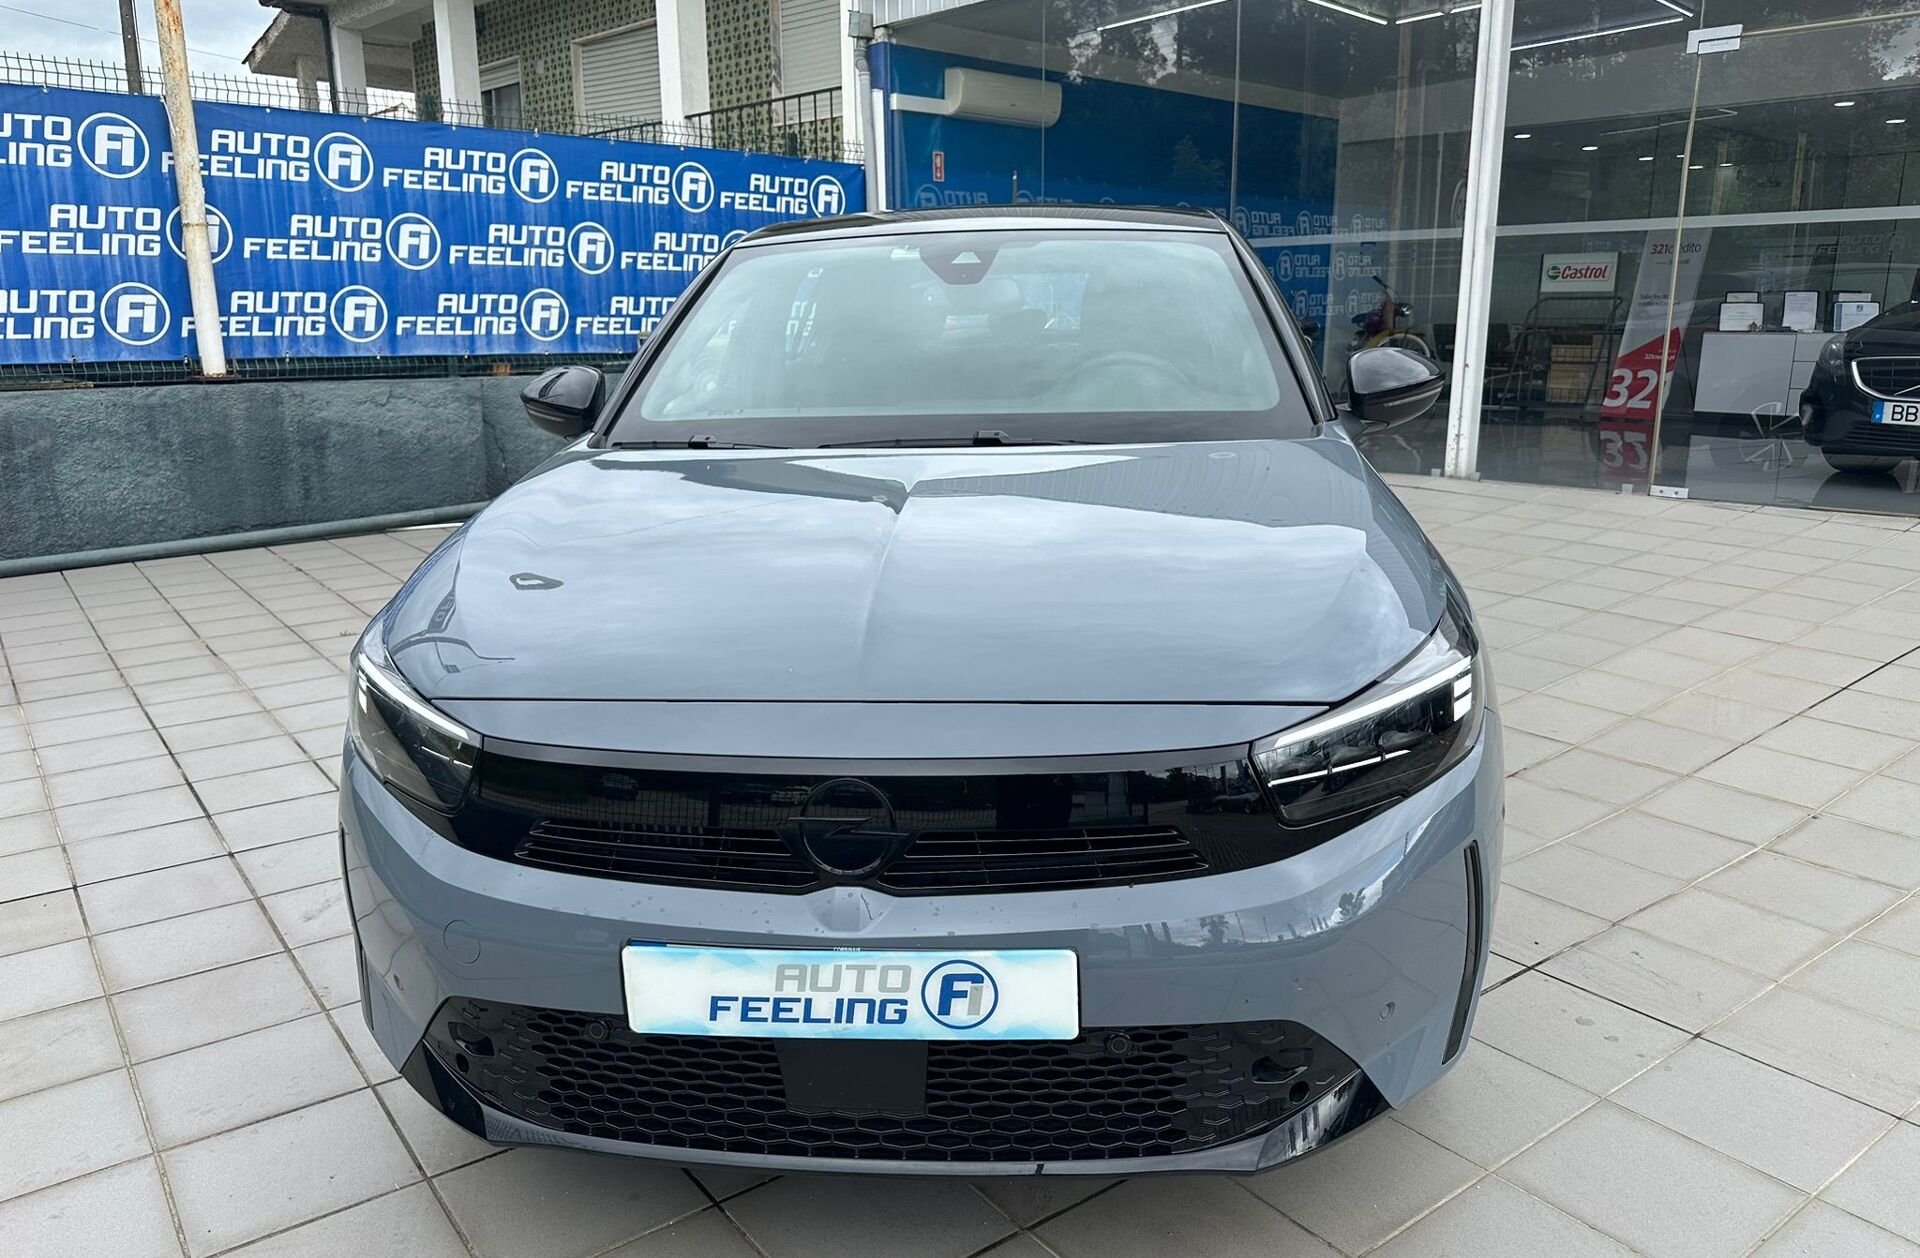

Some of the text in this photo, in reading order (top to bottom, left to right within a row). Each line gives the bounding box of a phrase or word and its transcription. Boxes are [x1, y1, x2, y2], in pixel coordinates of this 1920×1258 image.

[0, 113, 72, 141] TO
[212, 130, 309, 158] AUTO
[425, 148, 505, 172] AUTO
[384, 168, 505, 193] FEELING
[601, 162, 669, 184] AUTO
[567, 181, 669, 204] FEELING
[751, 174, 807, 195] AUTO
[721, 192, 807, 214] FEELING
[51, 204, 160, 230] AUTO
[291, 215, 381, 239] AUTO
[0, 231, 160, 255] FEELING
[489, 224, 564, 246] AUTO
[655, 233, 718, 252] AUTO
[244, 238, 381, 261] FEELING
[450, 246, 564, 266] FEELING
[1651, 243, 1701, 254] 321cdito
[1562, 265, 1608, 279] Castrol
[0, 290, 95, 313] UTO
[231, 292, 326, 312] AUTO
[438, 294, 517, 313] AUTO
[0, 317, 94, 339] LING
[397, 317, 516, 335] FEELING
[1891, 404, 1919, 422] BB
[775, 964, 912, 993] AUTO
[709, 996, 907, 1025] FEELING
